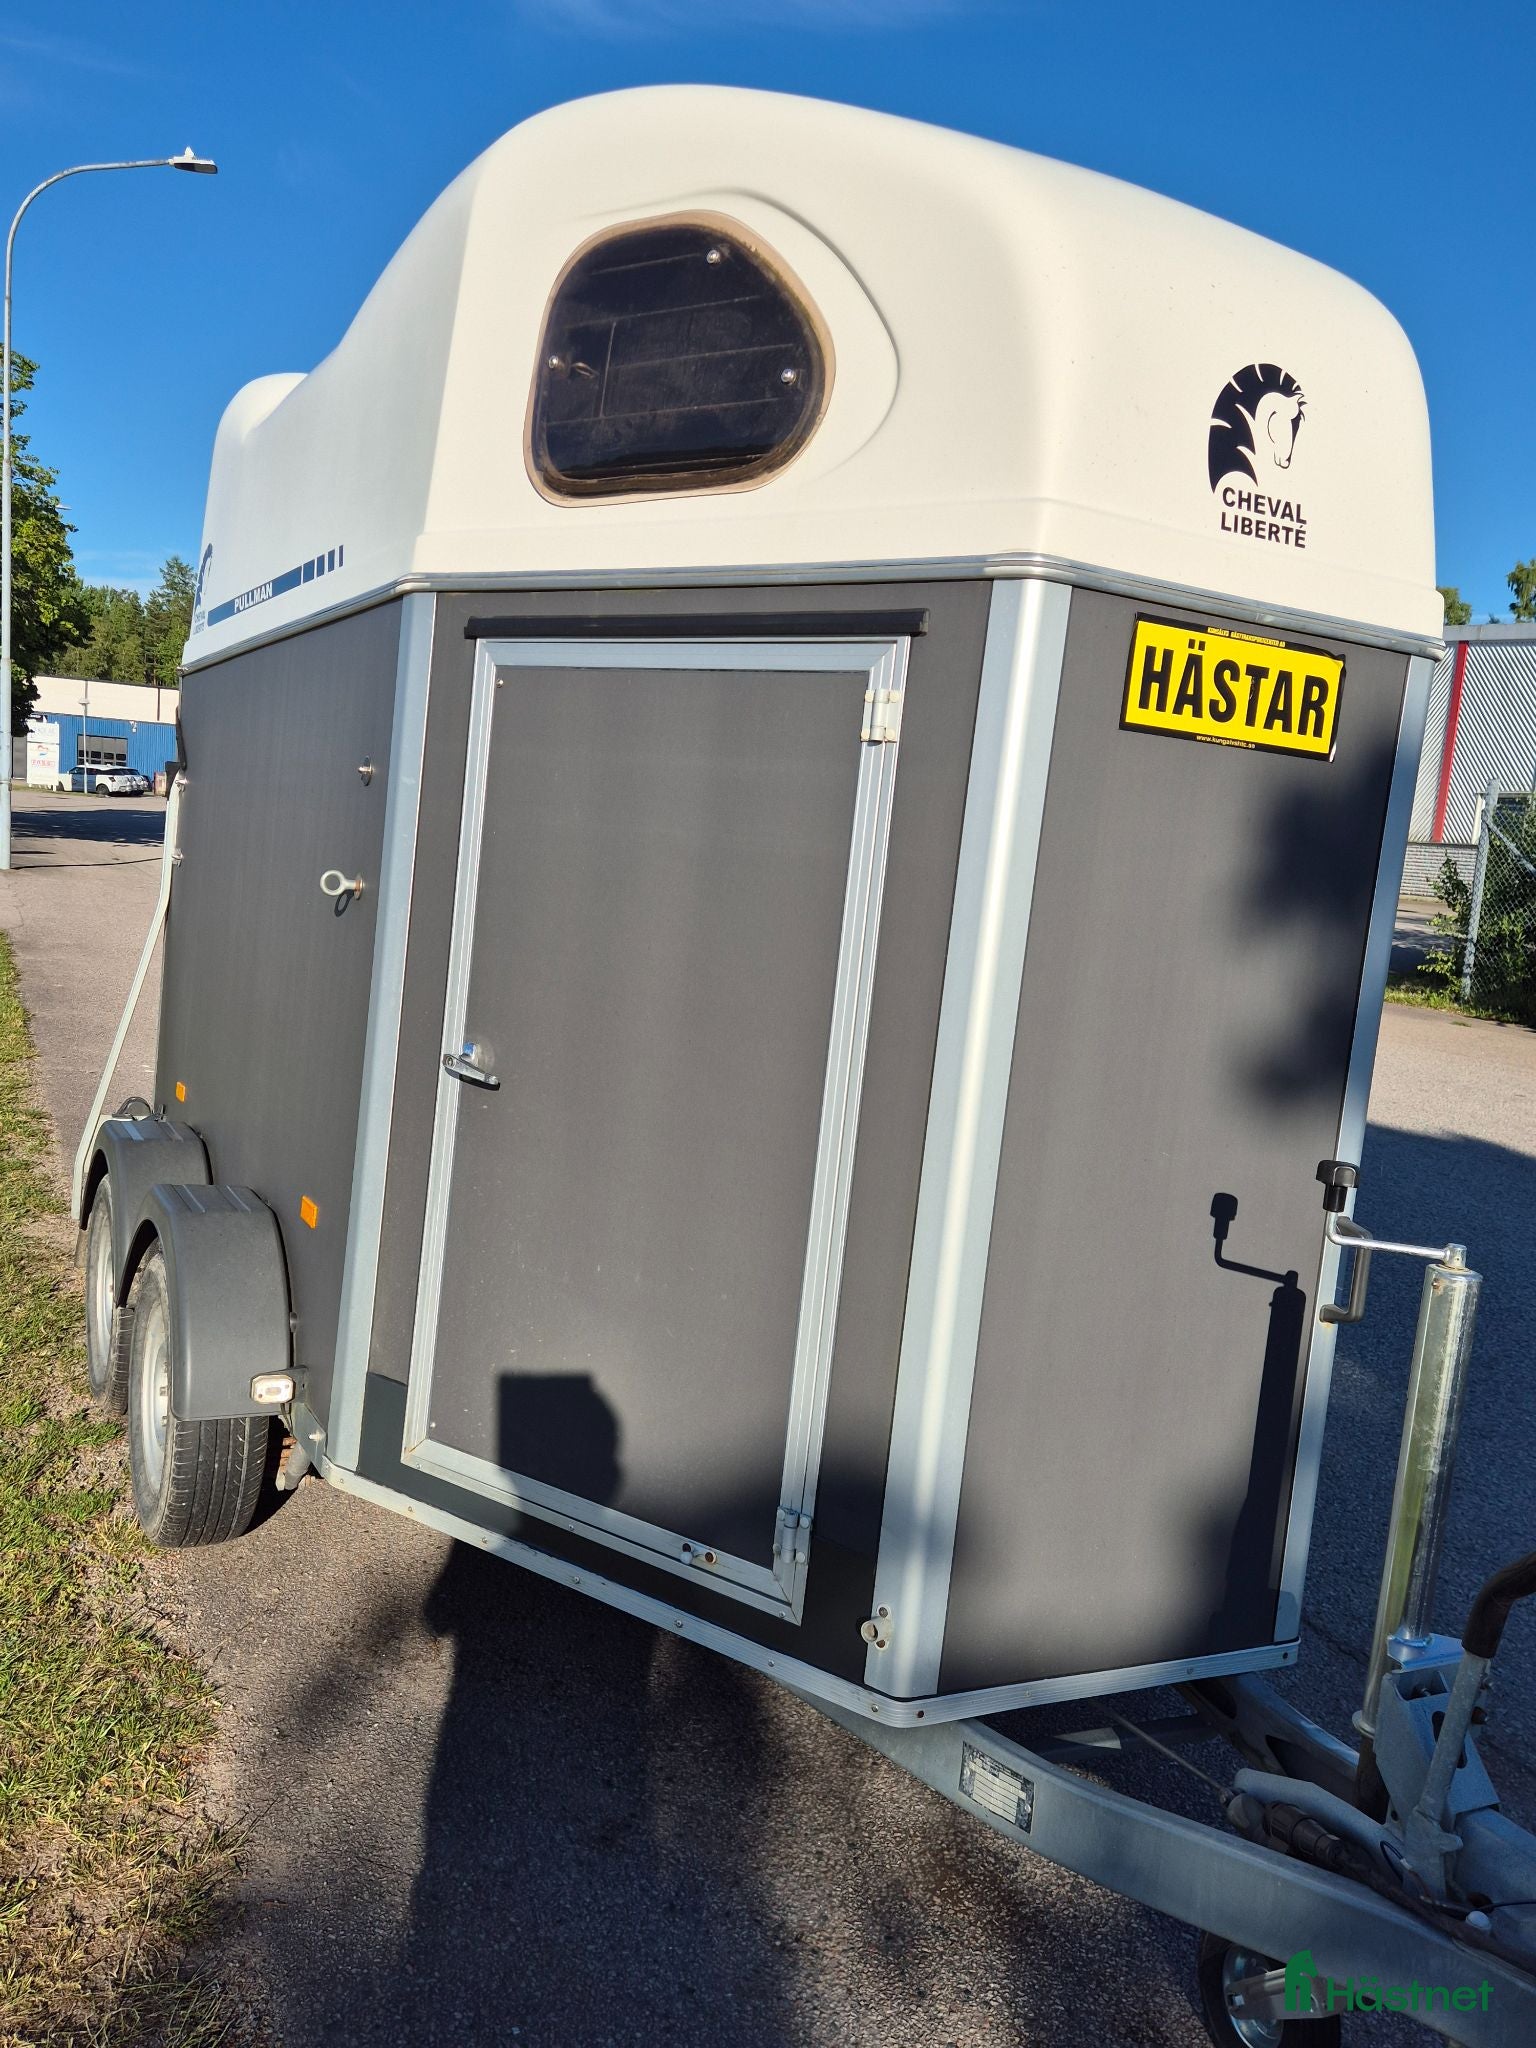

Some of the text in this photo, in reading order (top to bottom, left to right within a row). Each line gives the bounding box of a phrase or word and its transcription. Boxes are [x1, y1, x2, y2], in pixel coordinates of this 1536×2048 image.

[1222, 486, 1307, 525] CHEVAL
[1221, 511, 1306, 549] LIBERTÉ
[234, 581, 273, 613] PULLMAN
[1138, 638, 1329, 739] HÄSTAR
